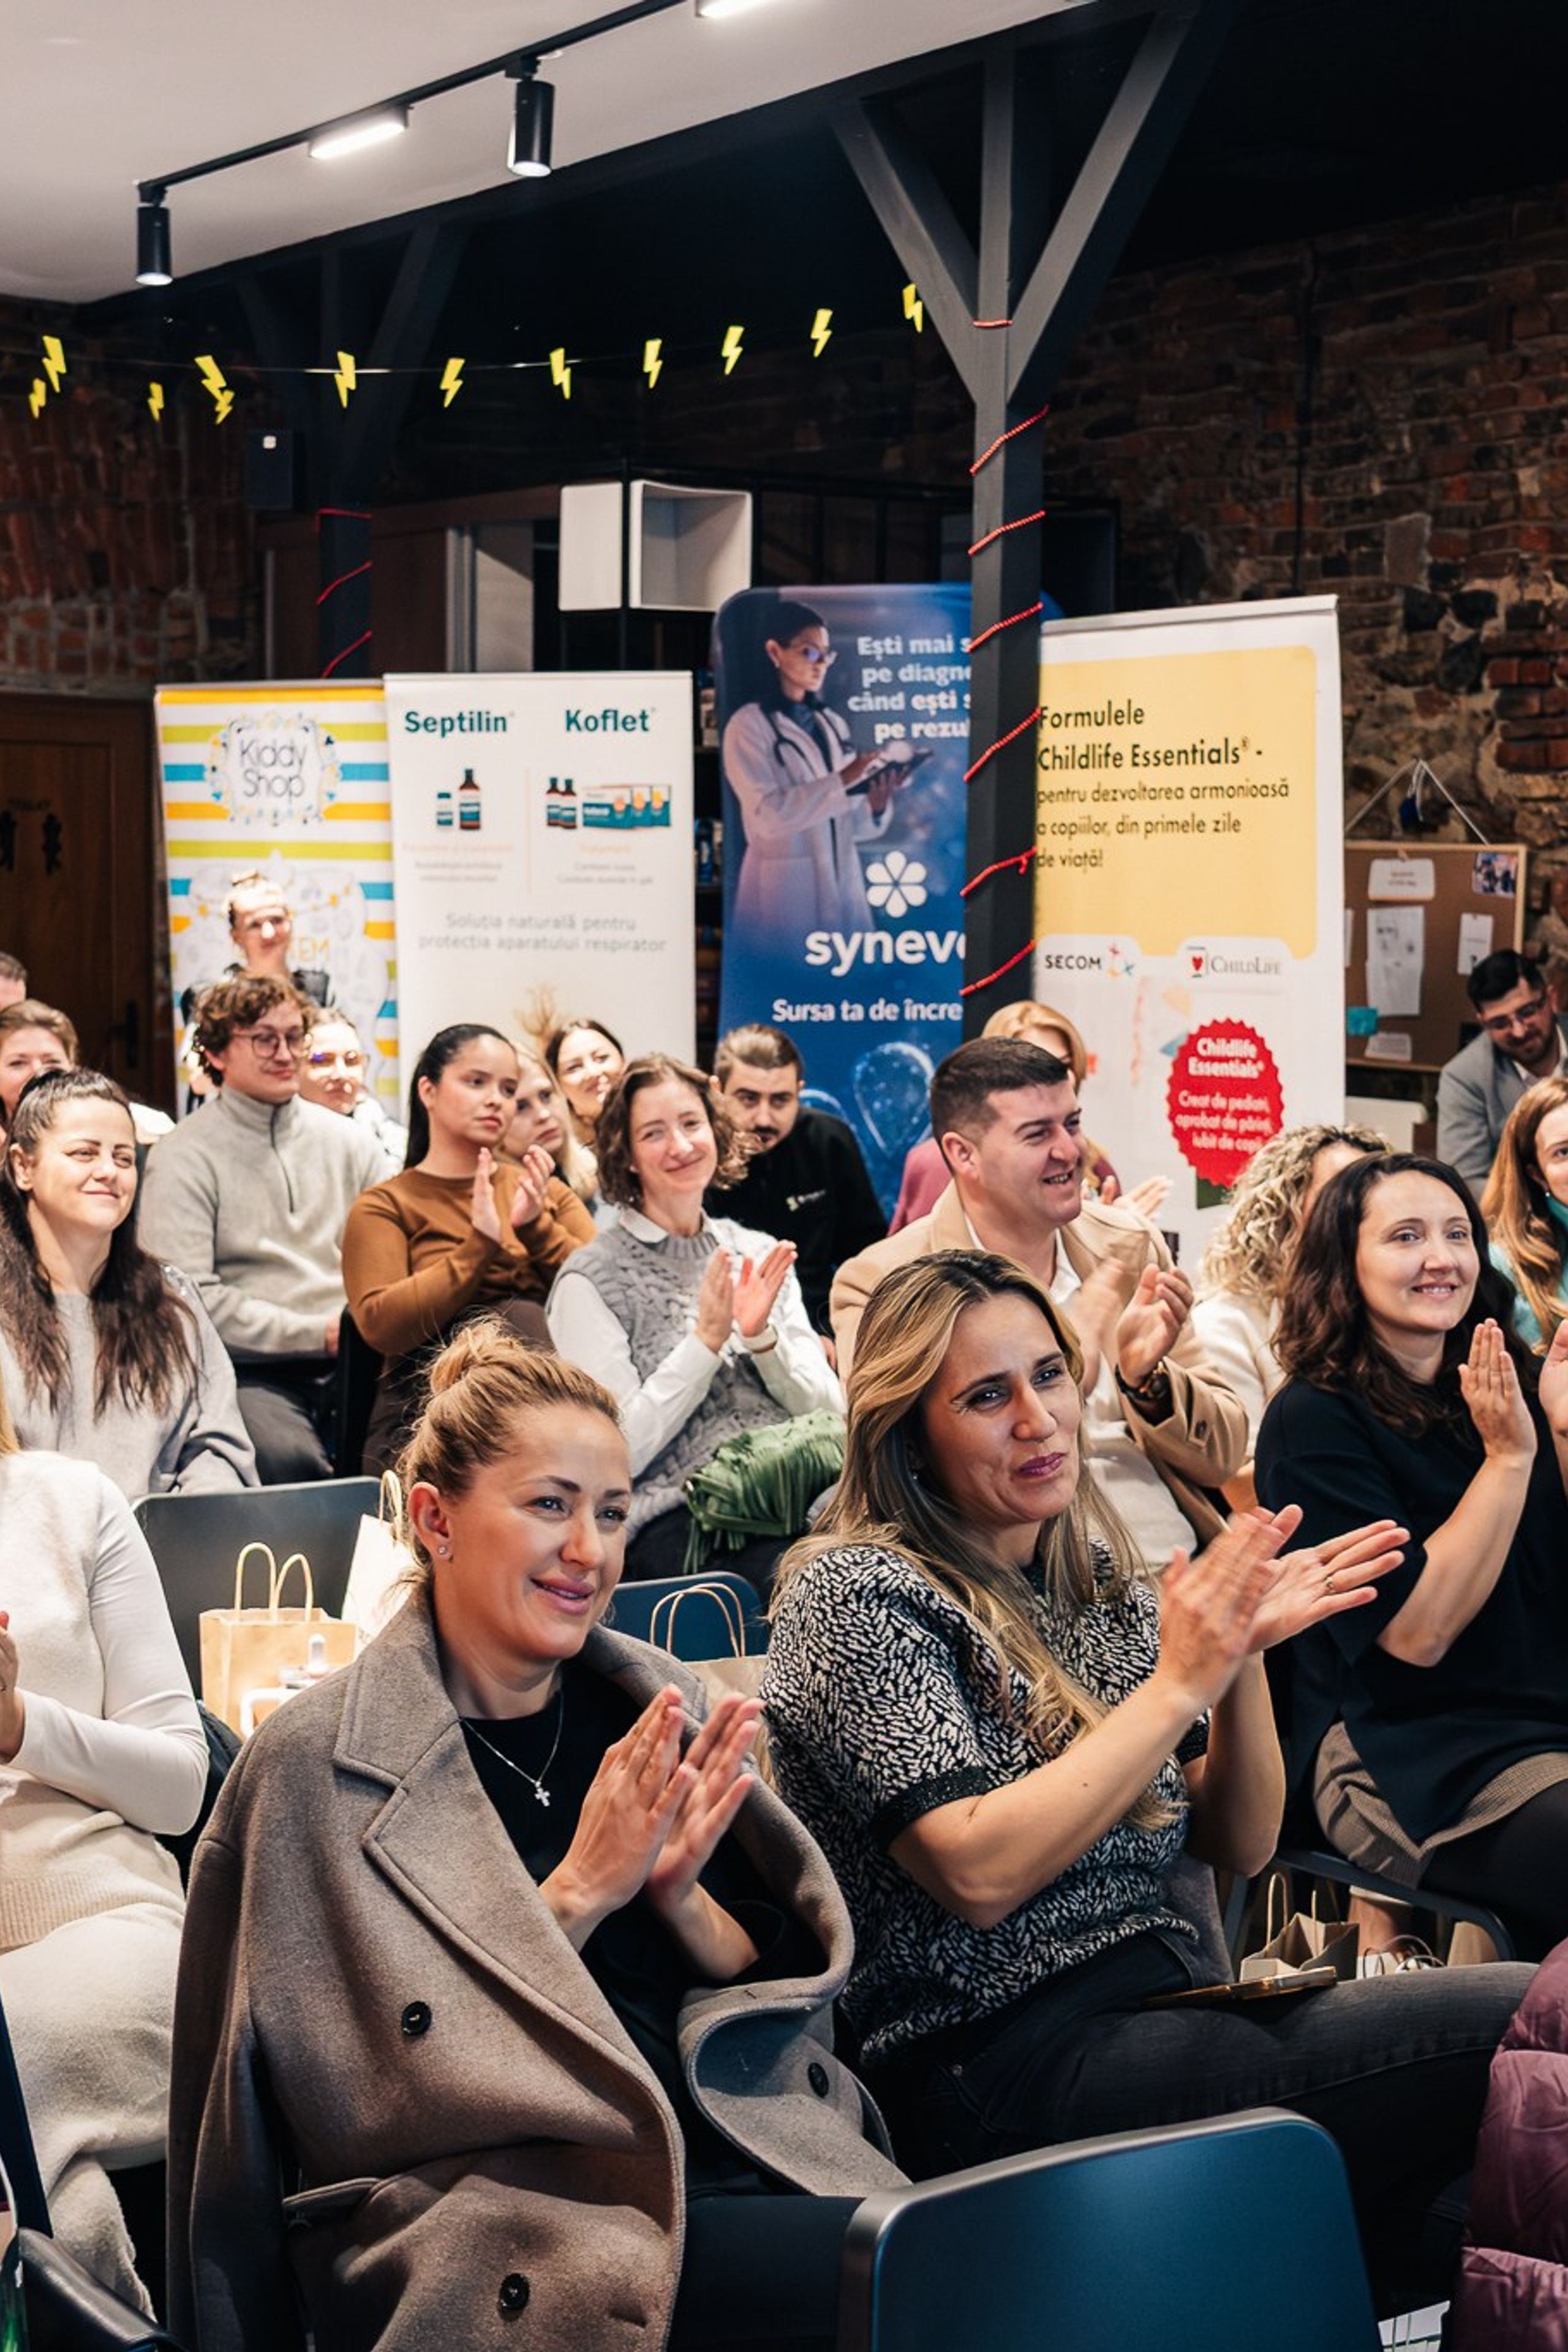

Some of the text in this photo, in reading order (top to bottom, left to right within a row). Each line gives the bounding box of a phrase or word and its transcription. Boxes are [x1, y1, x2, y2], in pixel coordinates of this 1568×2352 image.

[858, 635, 903, 660] Ești
[910, 635, 954, 654] mai
[862, 667, 892, 687] pe
[848, 692, 904, 711] când
[911, 692, 957, 715] ești
[1040, 699, 1144, 729] Formulele
[405, 711, 507, 737] Septilin
[565, 709, 649, 731] Koflet
[875, 723, 904, 744] pe
[239, 739, 307, 777] Kiddy
[1038, 742, 1123, 771] Childlife
[244, 769, 304, 804] Shop
[1038, 778, 1289, 809] pentru dezvoltarea armonioasă
[1116, 813, 1139, 835] din
[1144, 813, 1206, 839] primele
[1213, 812, 1242, 834] zile
[1037, 848, 1054, 869] de
[508, 913, 576, 930] naturală
[582, 918, 636, 932] pentru
[1044, 955, 1102, 970] SECOM
[772, 998, 835, 1022] Sursa
[841, 1000, 864, 1022] ta
[869, 997, 899, 1022] de
